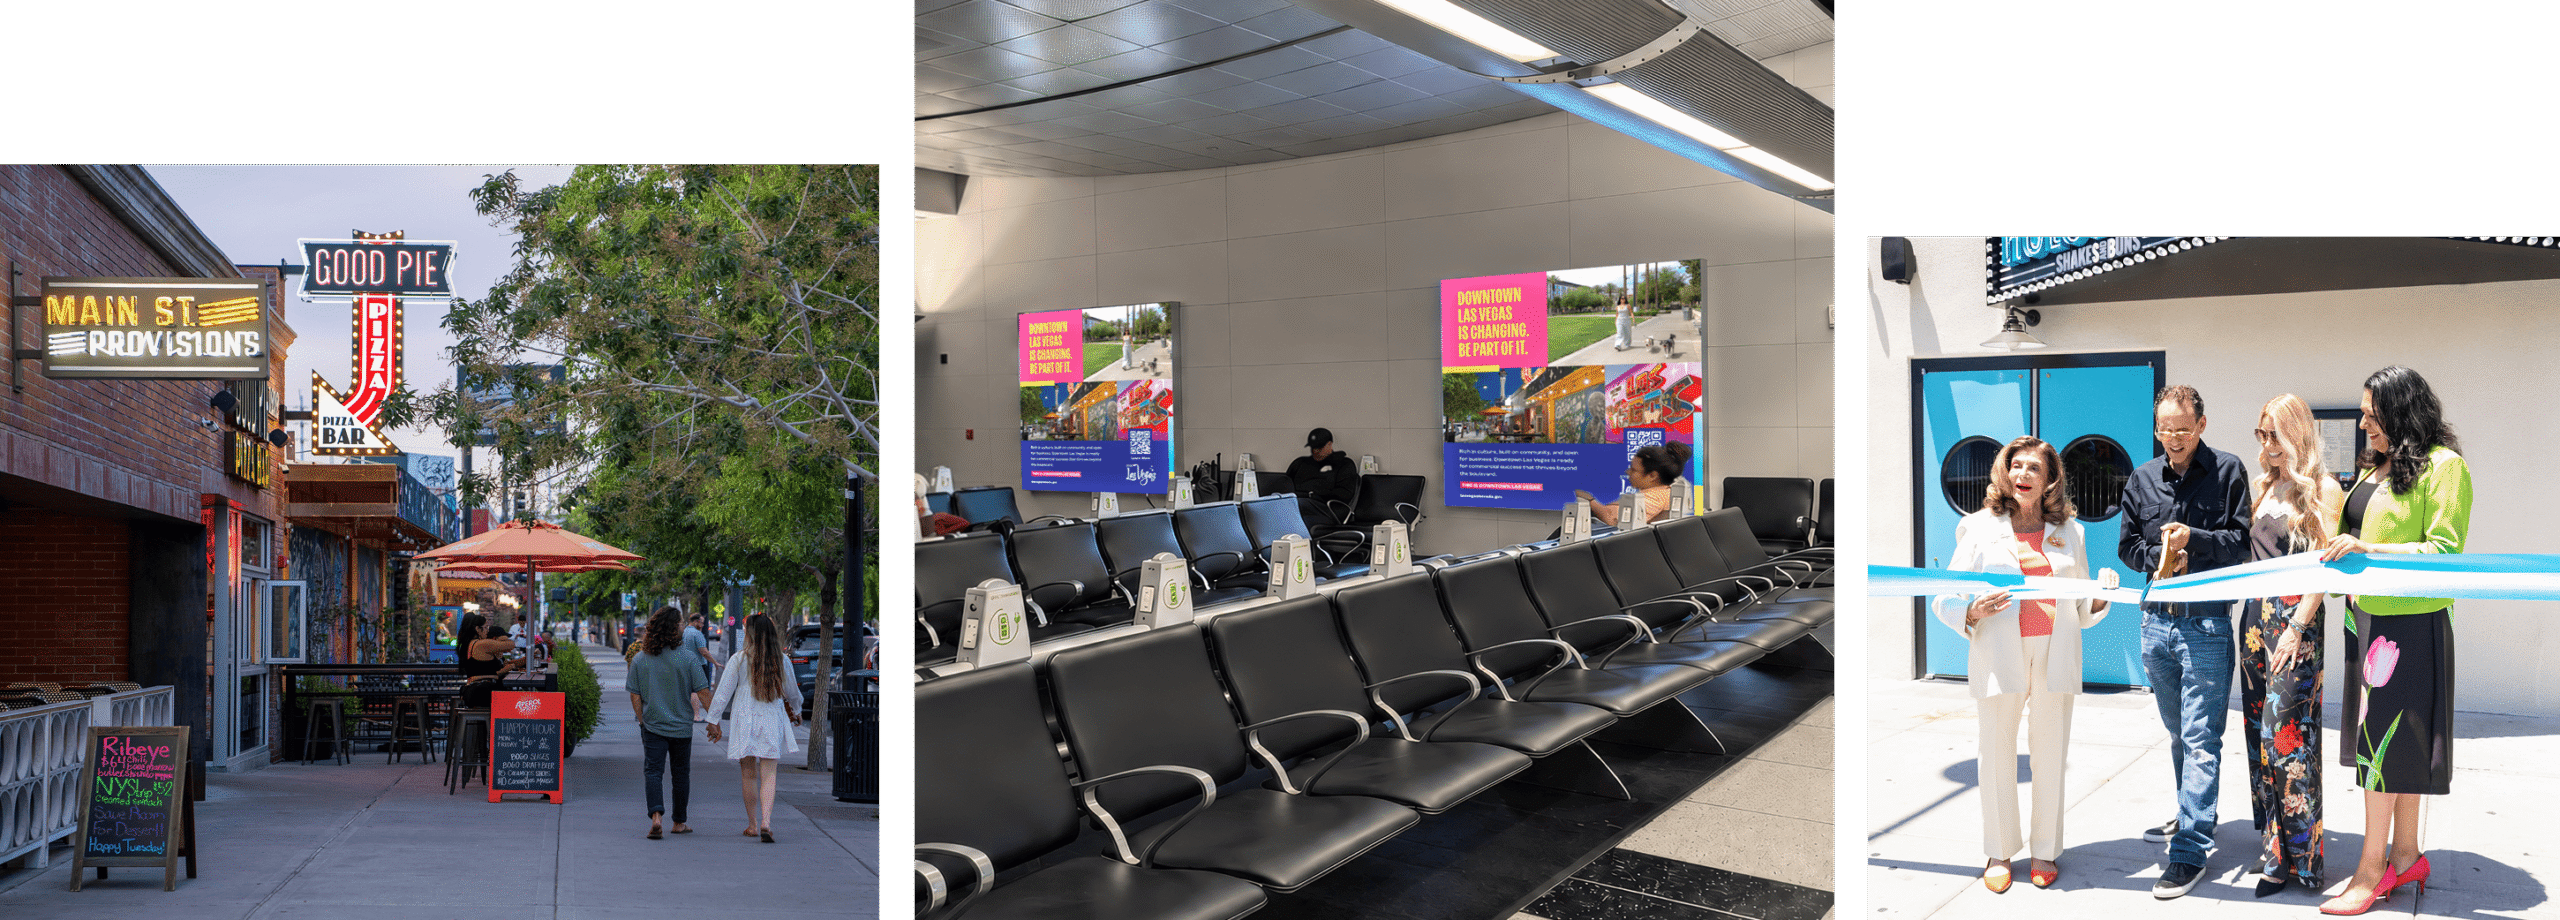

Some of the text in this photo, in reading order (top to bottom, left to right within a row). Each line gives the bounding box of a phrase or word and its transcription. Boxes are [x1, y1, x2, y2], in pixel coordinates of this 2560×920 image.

[2056, 242, 2100, 273] SHAKES
[2099, 240, 2107, 260] AND
[2107, 236, 2141, 259] BUNS
[315, 249, 438, 287] GOOD PIE
[1457, 287, 1521, 306] DOWNTOWN
[46, 294, 197, 326] MAIN ST.
[1458, 305, 1513, 323] LAS VEGAS
[1029, 321, 1068, 335] DOWNTOWN
[1458, 322, 1530, 340] IS CHANGING.
[89, 330, 260, 357] PROVISIONS
[369, 302, 387, 389] PIZZA
[1029, 336, 1041, 348] LAS
[1458, 340, 1528, 357] BE PART OF IT.
[322, 416, 355, 427] PIZZA
[322, 427, 365, 445] BAR
[501, 722, 555, 734] HAPPY HOUR
[103, 736, 170, 766] Ribeye
[101, 755, 126, 769] $64
[153, 781, 173, 796] $52
[94, 806, 166, 820] Save Room
[94, 820, 112, 834] For
[89, 836, 165, 854] Happy Tuesday!
